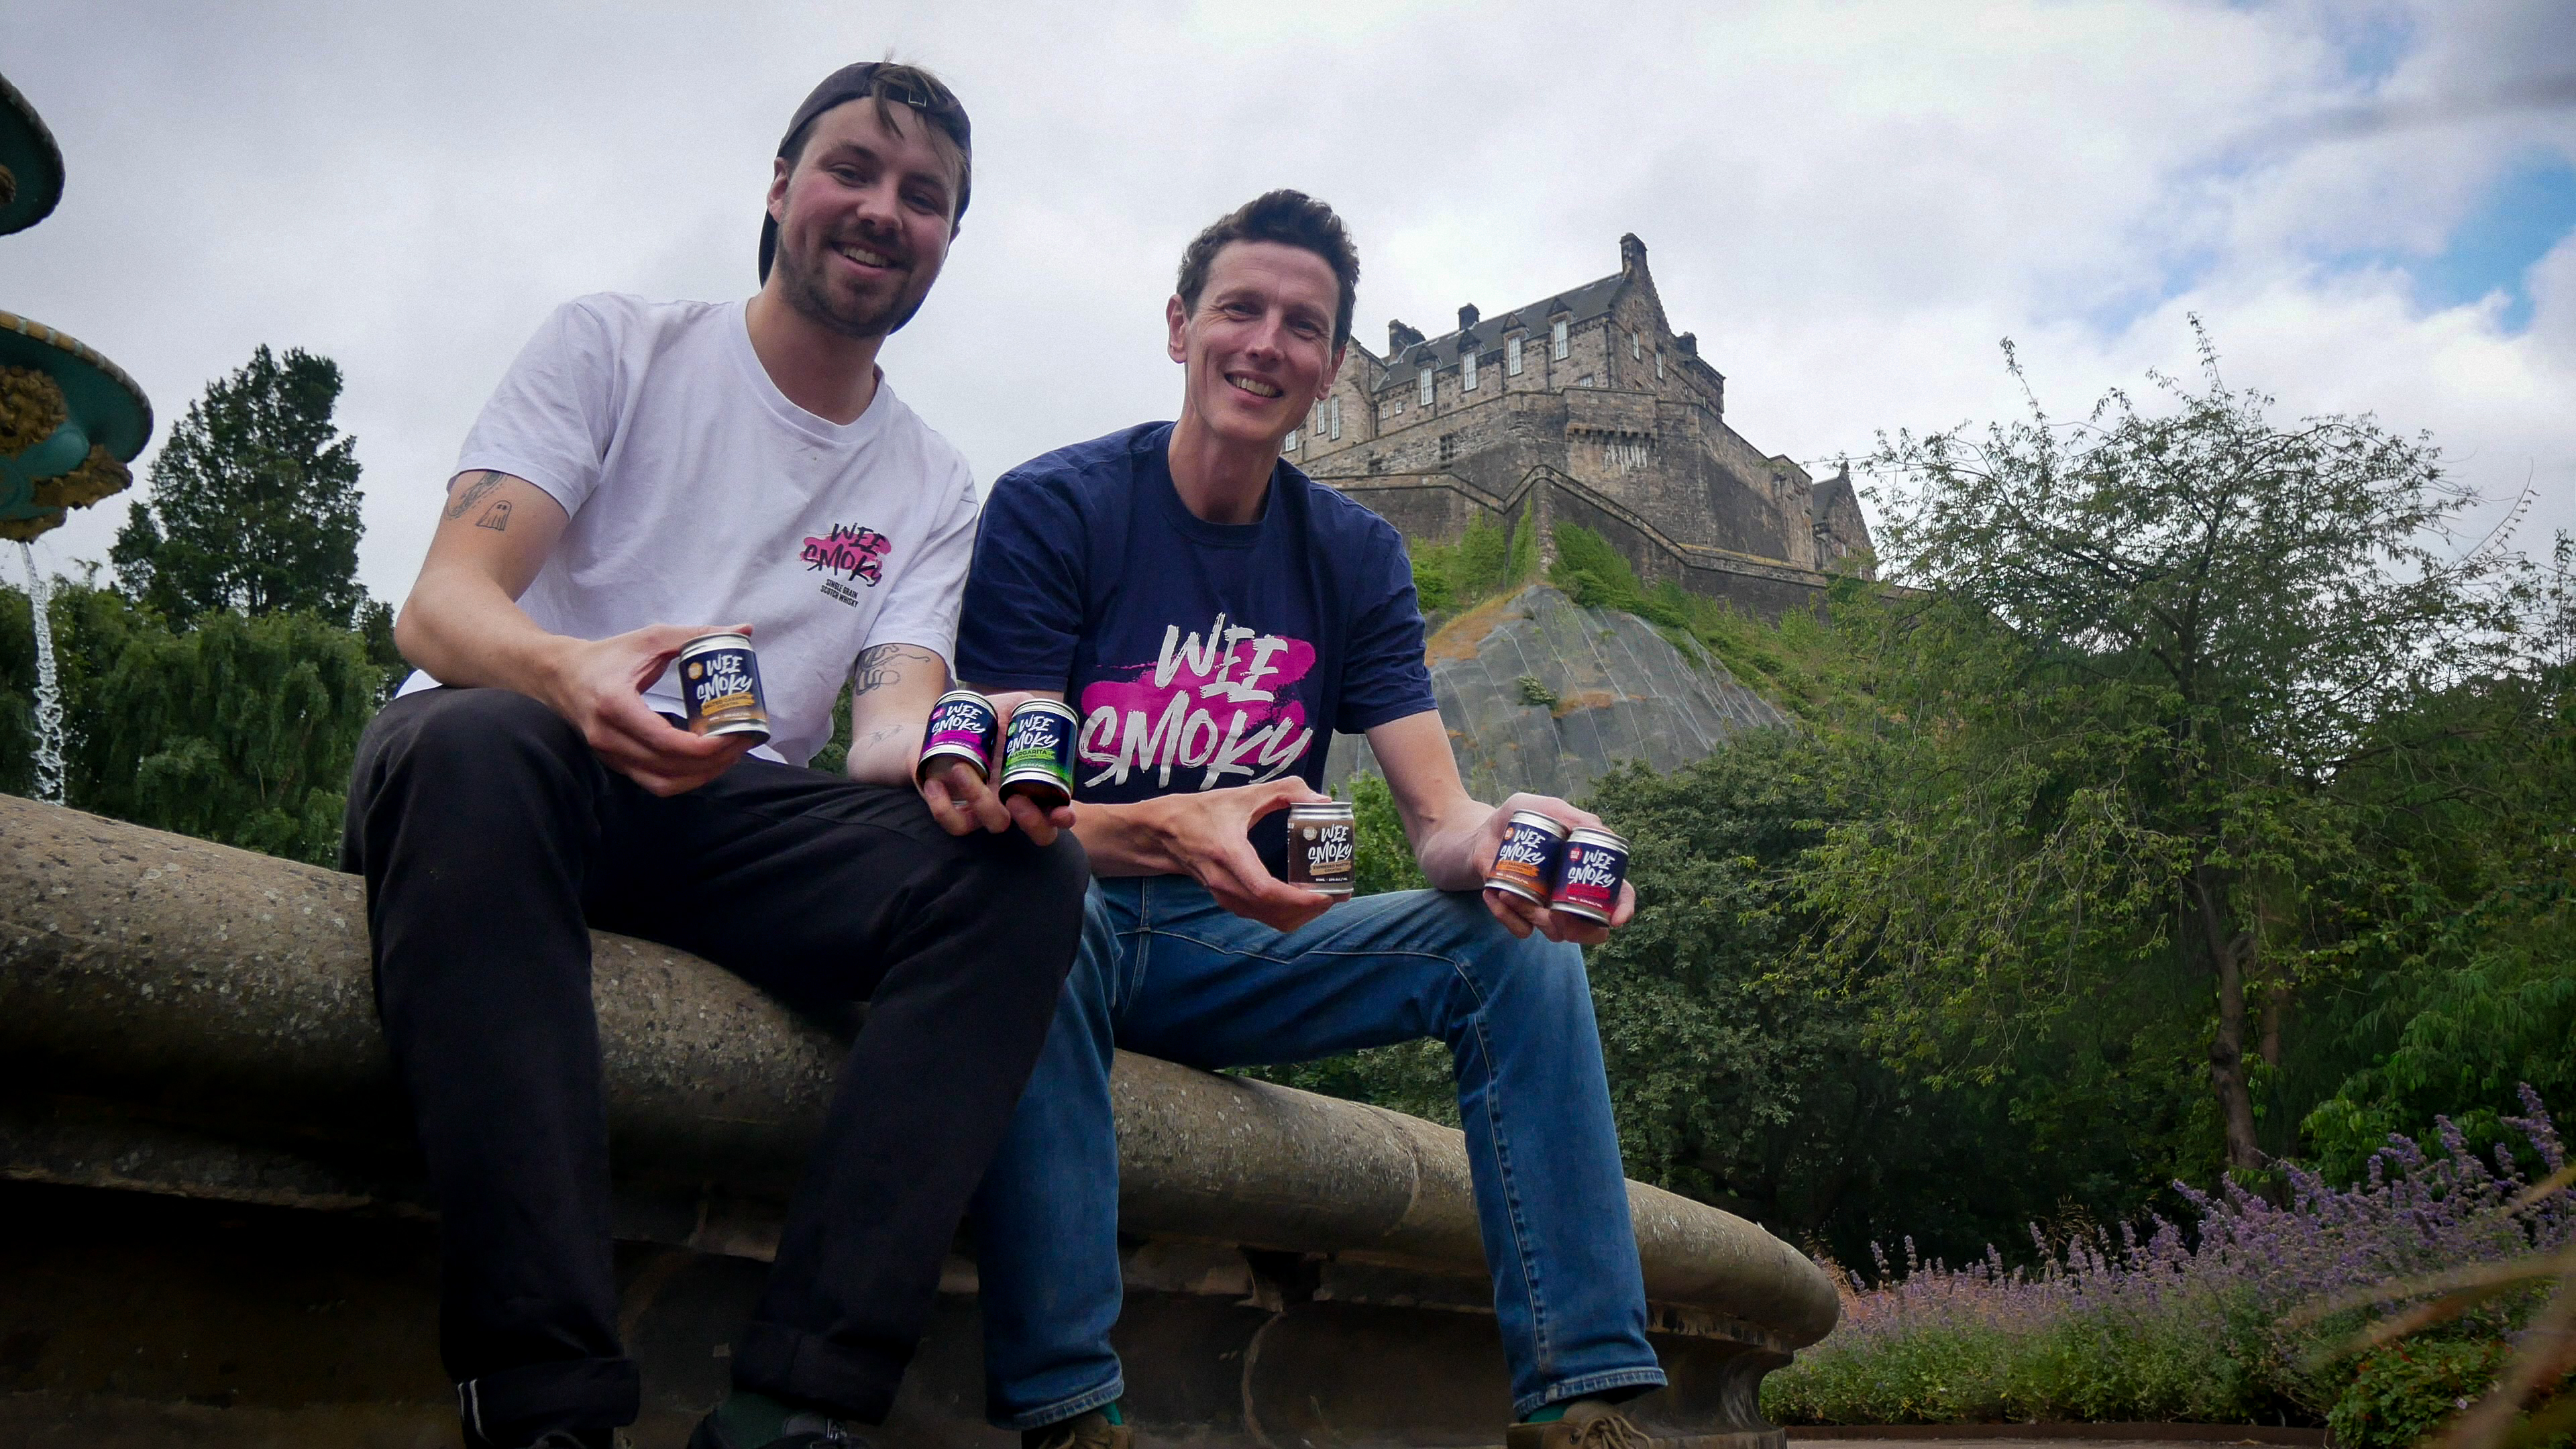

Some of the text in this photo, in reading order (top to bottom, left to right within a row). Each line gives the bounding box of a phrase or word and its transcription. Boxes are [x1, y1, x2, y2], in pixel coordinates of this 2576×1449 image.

[831, 523, 886, 556] WEE
[804, 543, 883, 588] SMOKY
[820, 584, 859, 608] SCOTCH WHISKY
[826, 578, 858, 600] SINGLE GRAIN
[706, 654, 743, 677] WEE
[1154, 612, 1288, 702] WEE
[696, 674, 753, 706] SMOKY
[946, 703, 983, 719] WEE
[931, 714, 987, 736] SMOKY
[1019, 714, 1055, 733] WEE
[1006, 731, 1060, 757] SMOKY
[1079, 690, 1313, 792] SMOKY
[1010, 749, 1047, 758] MARGARITA
[1321, 823, 1349, 843] WEE
[1513, 828, 1546, 849] WEE
[1308, 841, 1353, 866] SMOKY
[1499, 842, 1546, 865] SMOKY
[1582, 850, 1615, 870] WEE
[1568, 864, 1616, 888] SMOKY
